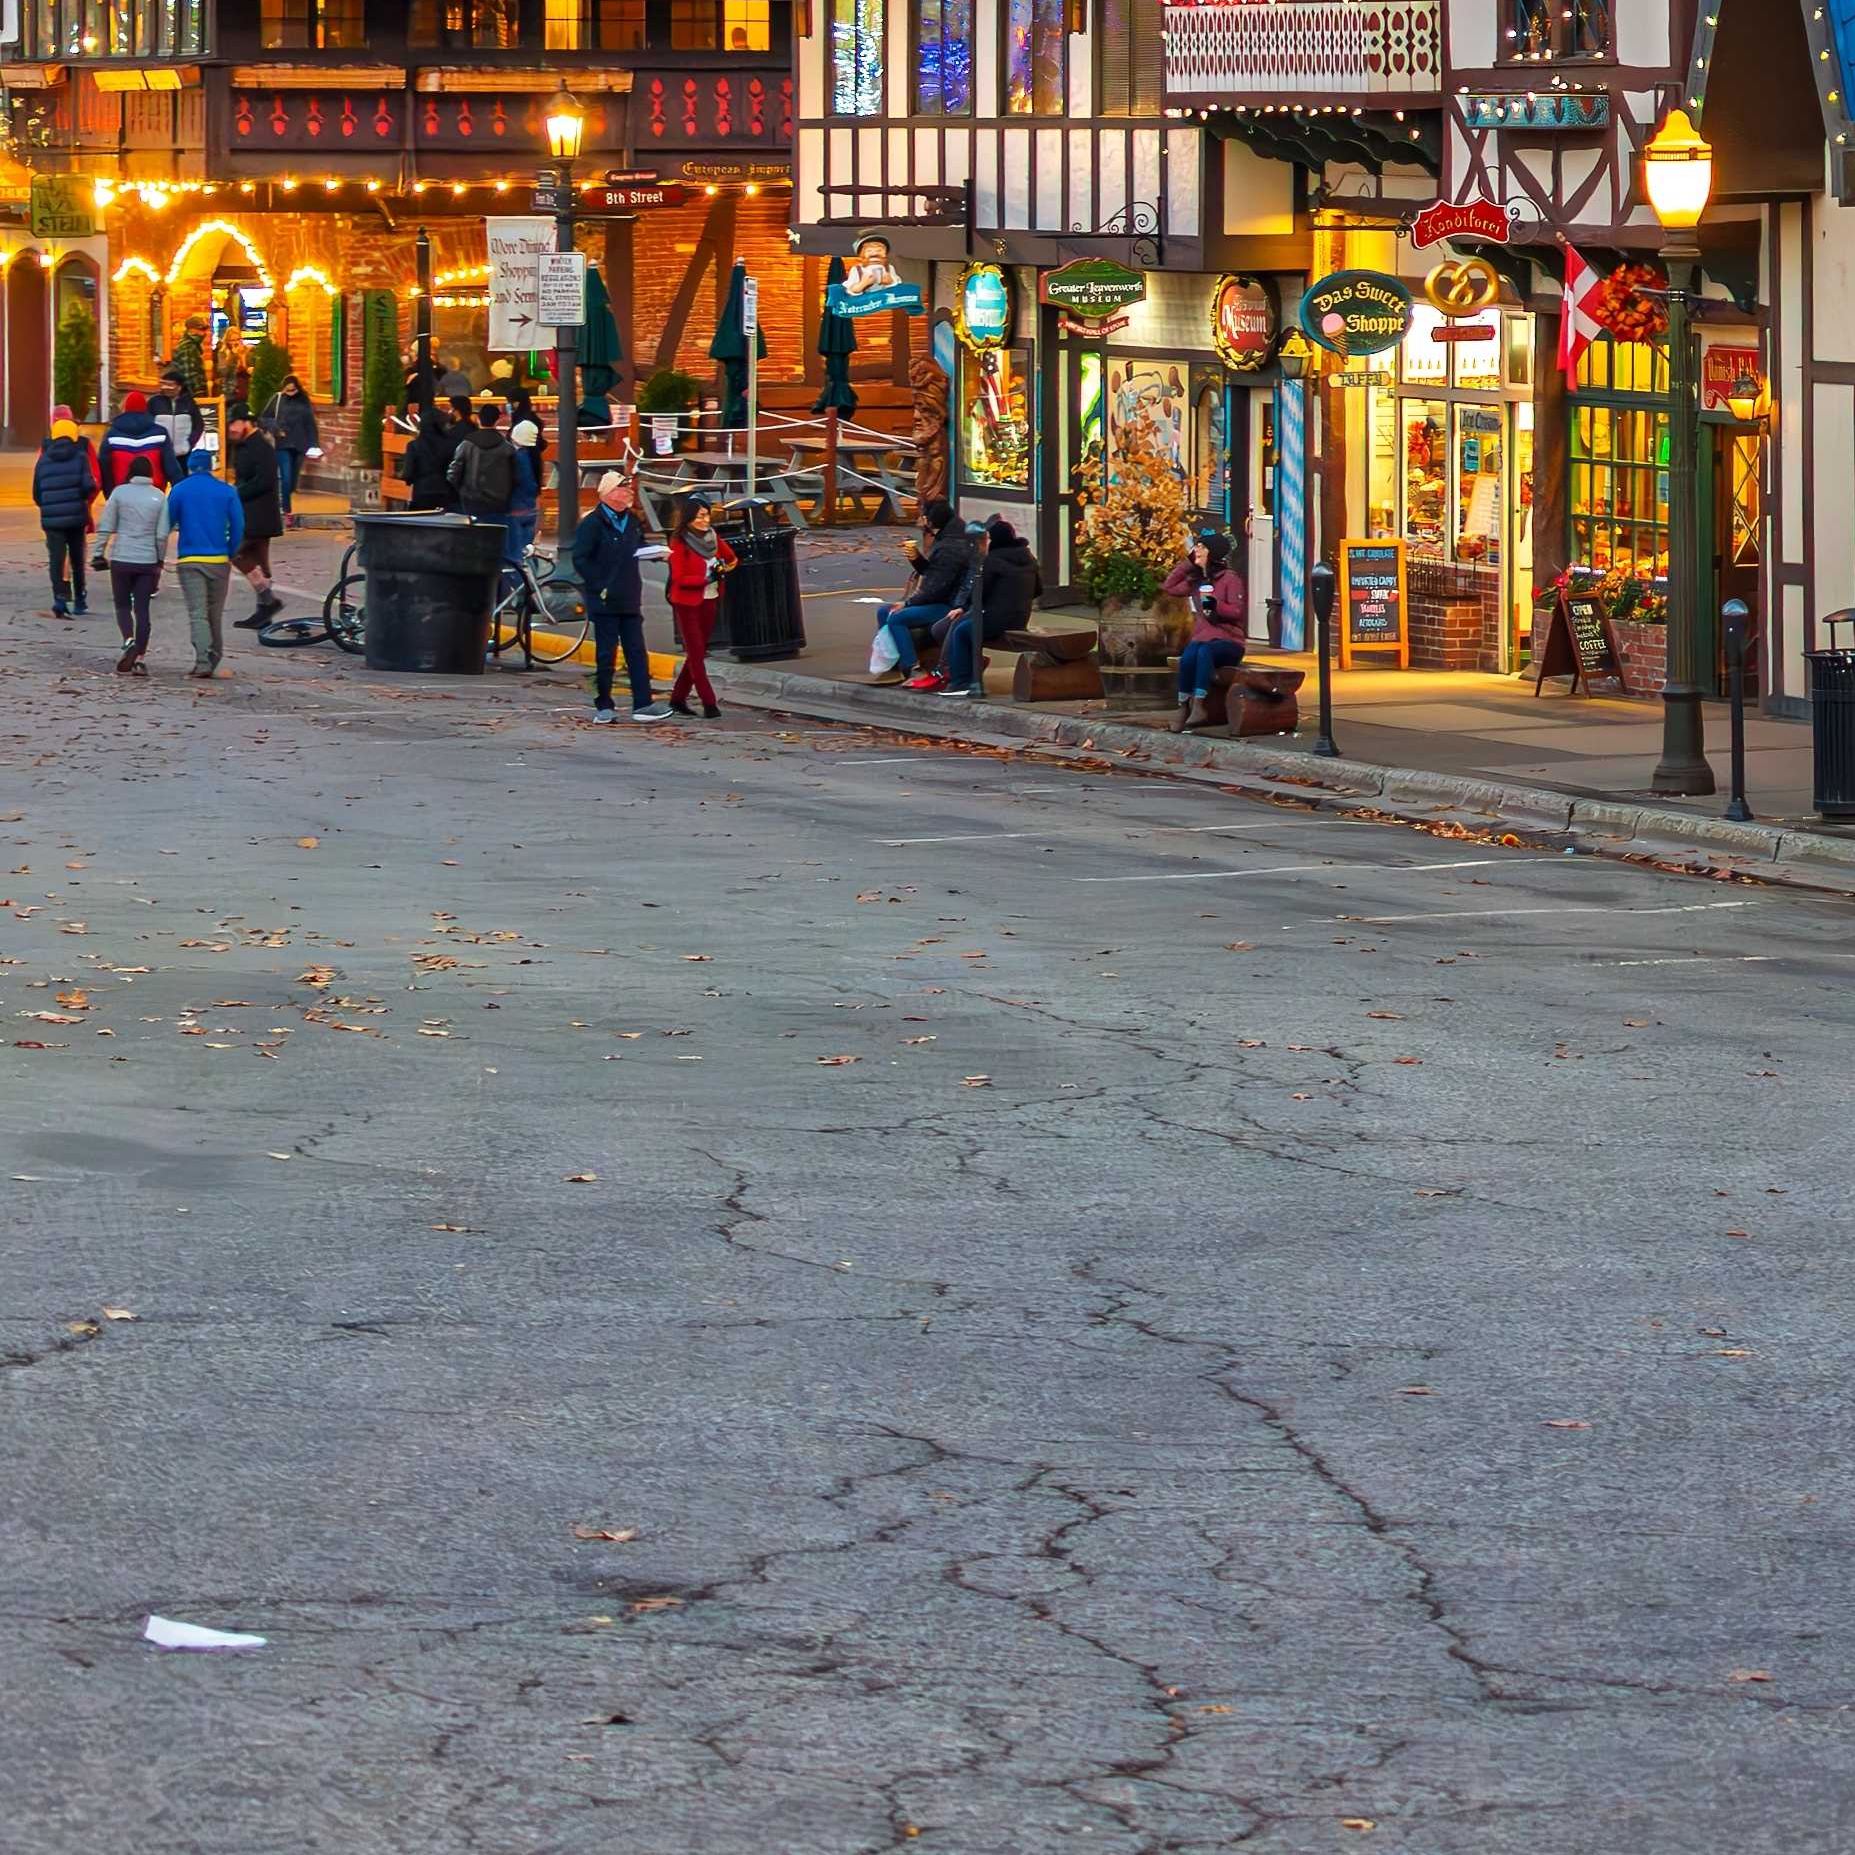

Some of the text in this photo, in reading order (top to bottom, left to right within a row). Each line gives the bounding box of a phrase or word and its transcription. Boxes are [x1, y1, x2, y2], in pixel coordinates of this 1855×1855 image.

[682, 161, 741, 176] European
[606, 191, 664, 205] 8th Street
[1422, 209, 1503, 238] Konditorei
[1048, 281, 1143, 295] Greater Leavenworth
[1071, 295, 1122, 303] MUSEUM
[1313, 281, 1408, 313] Das Sweet
[1222, 303, 1268, 340] Museum
[1346, 314, 1405, 335] Shoppe
[1580, 639, 1607, 651] COFFEE
